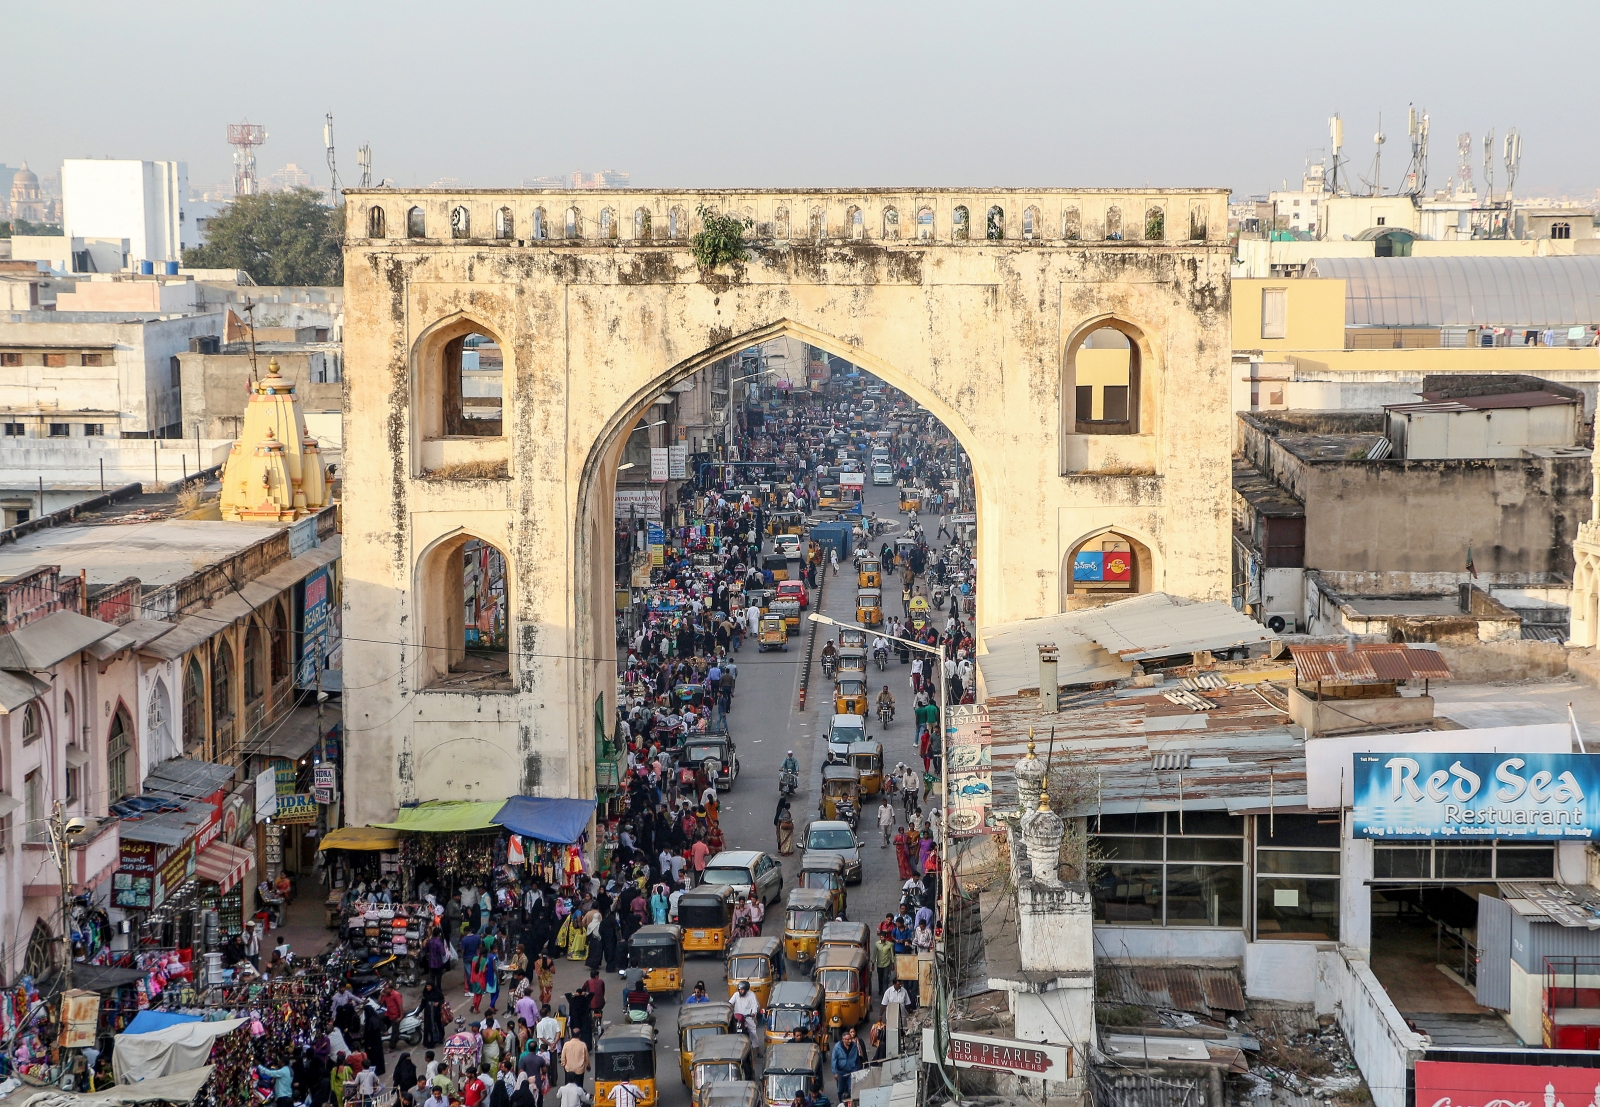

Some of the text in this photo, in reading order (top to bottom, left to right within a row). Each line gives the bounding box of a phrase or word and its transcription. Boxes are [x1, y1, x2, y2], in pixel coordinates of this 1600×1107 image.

[304, 601, 327, 629] PEARLS
[315, 770, 332, 778] SIDRA
[1384, 757, 1585, 804] Red Sea
[276, 794, 317, 809] SIDRA
[282, 804, 317, 815] PEARLS
[1444, 804, 1583, 825] Restuarant
[1368, 826, 1593, 838] Veg & Non-Veg Spl. Chicken Biryani Meals Ready
[954, 1040, 1042, 1064] SS PEARLS
[954, 1053, 978, 1062] GEMS
[990, 1058, 1042, 1071] JEWELLERS
